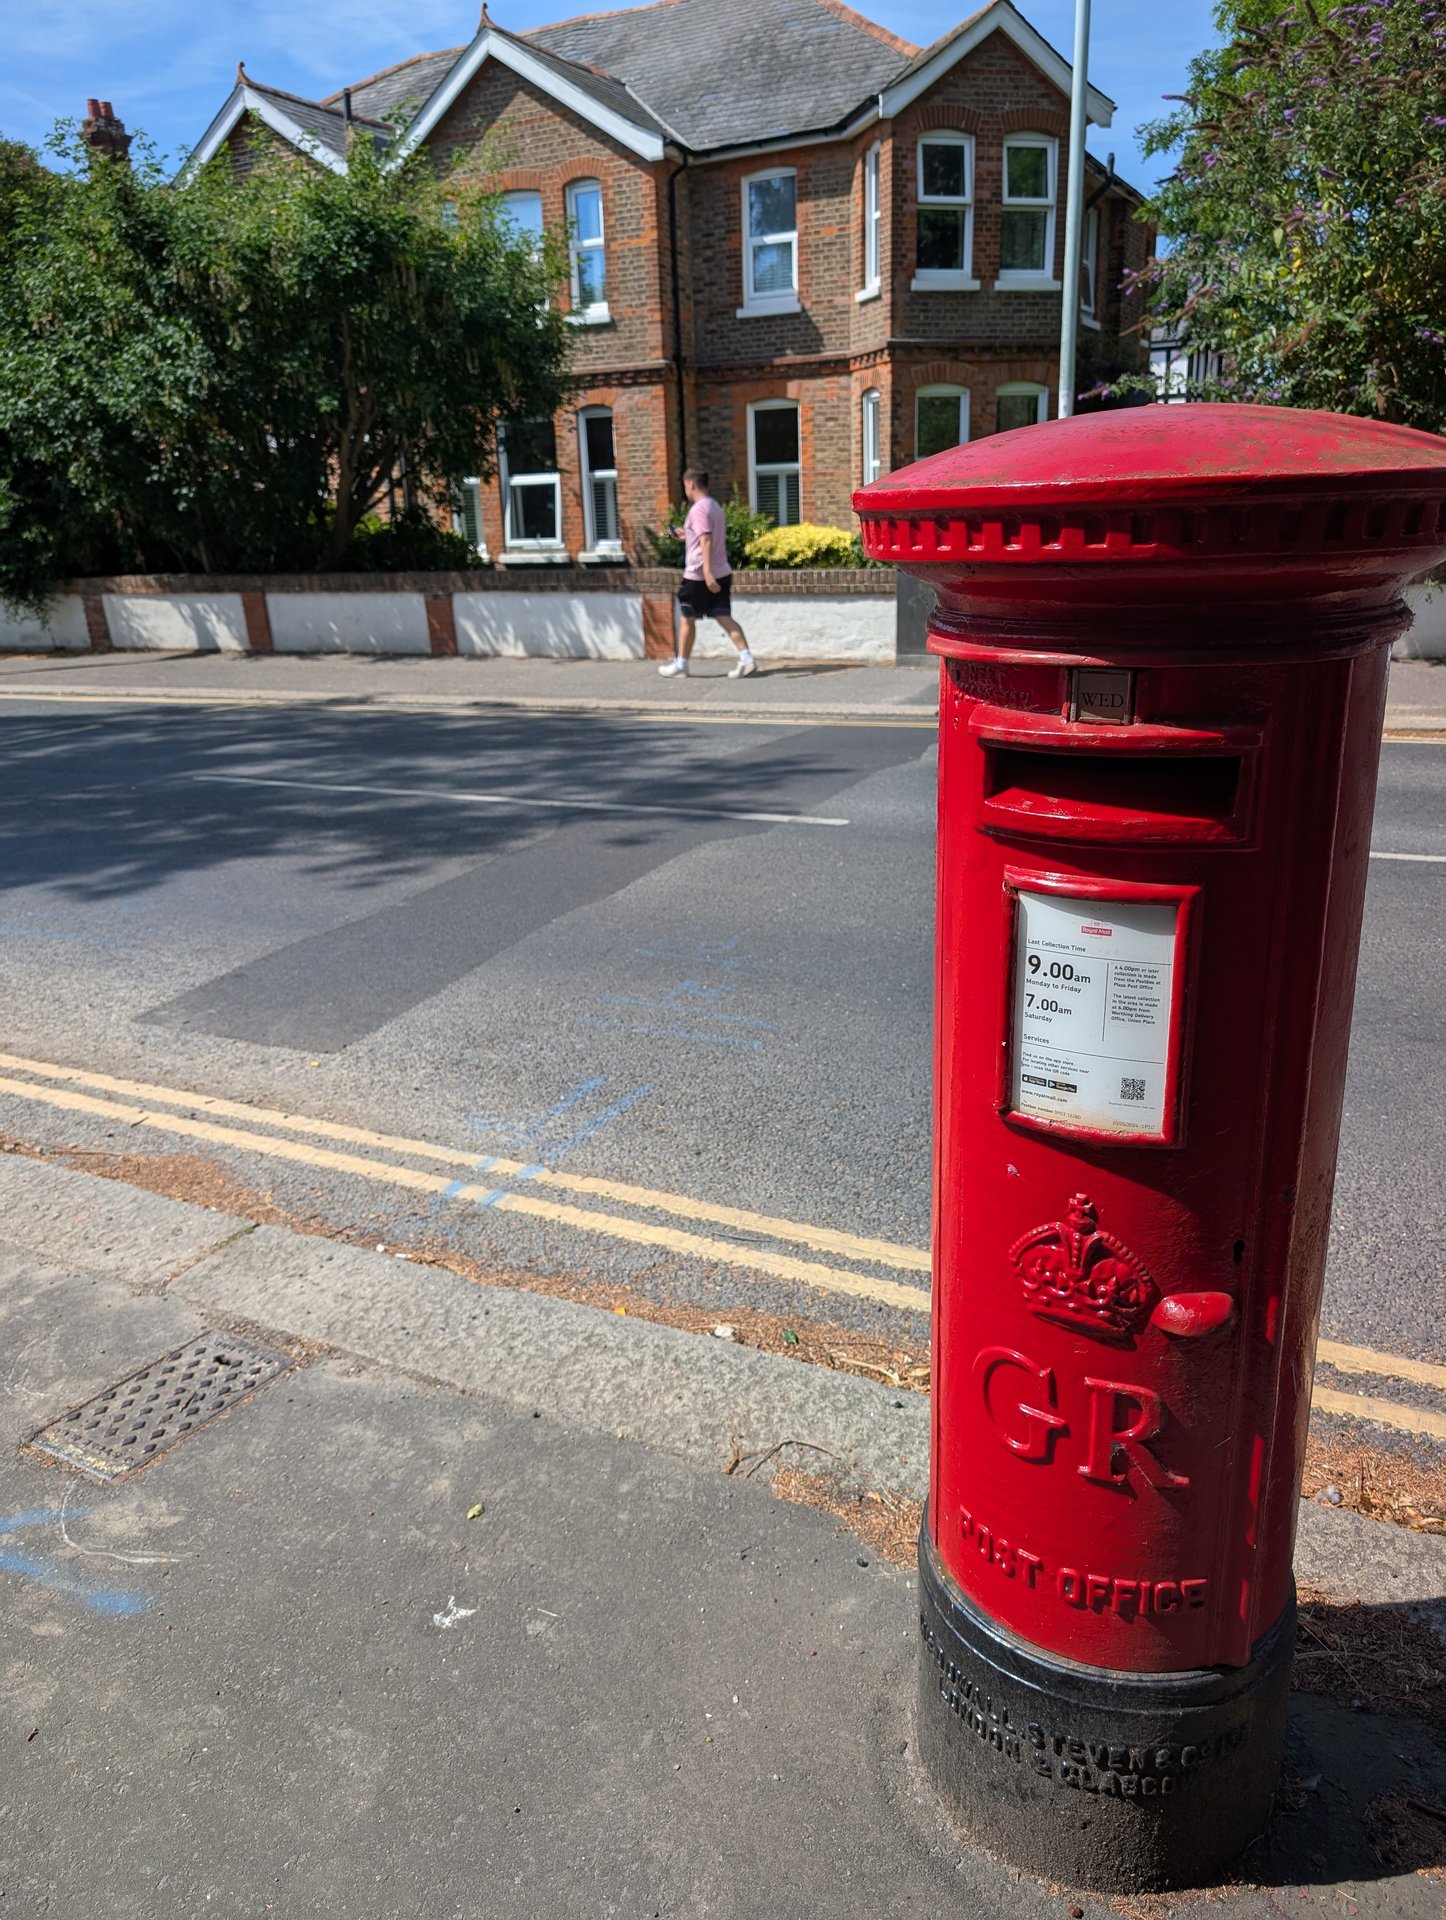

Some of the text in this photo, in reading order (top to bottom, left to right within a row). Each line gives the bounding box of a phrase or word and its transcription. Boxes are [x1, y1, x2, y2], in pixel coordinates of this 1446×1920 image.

[1082, 692, 1124, 708] WED
[1042, 940, 1070, 950] Collection
[1071, 944, 1086, 952] Time
[1028, 955, 1090, 983] 9.00am
[1026, 978, 1050, 988] Monday
[1061, 984, 1081, 993] Friday
[1025, 994, 1072, 1015] 7.00am
[1024, 1012, 1052, 1023] Saturday
[1024, 1034, 1049, 1044] Services
[1021, 1090, 1067, 1102] www.royalmail.com
[972, 1346, 1189, 1487] GR
[960, 1505, 1207, 1615] POST OFFICE
